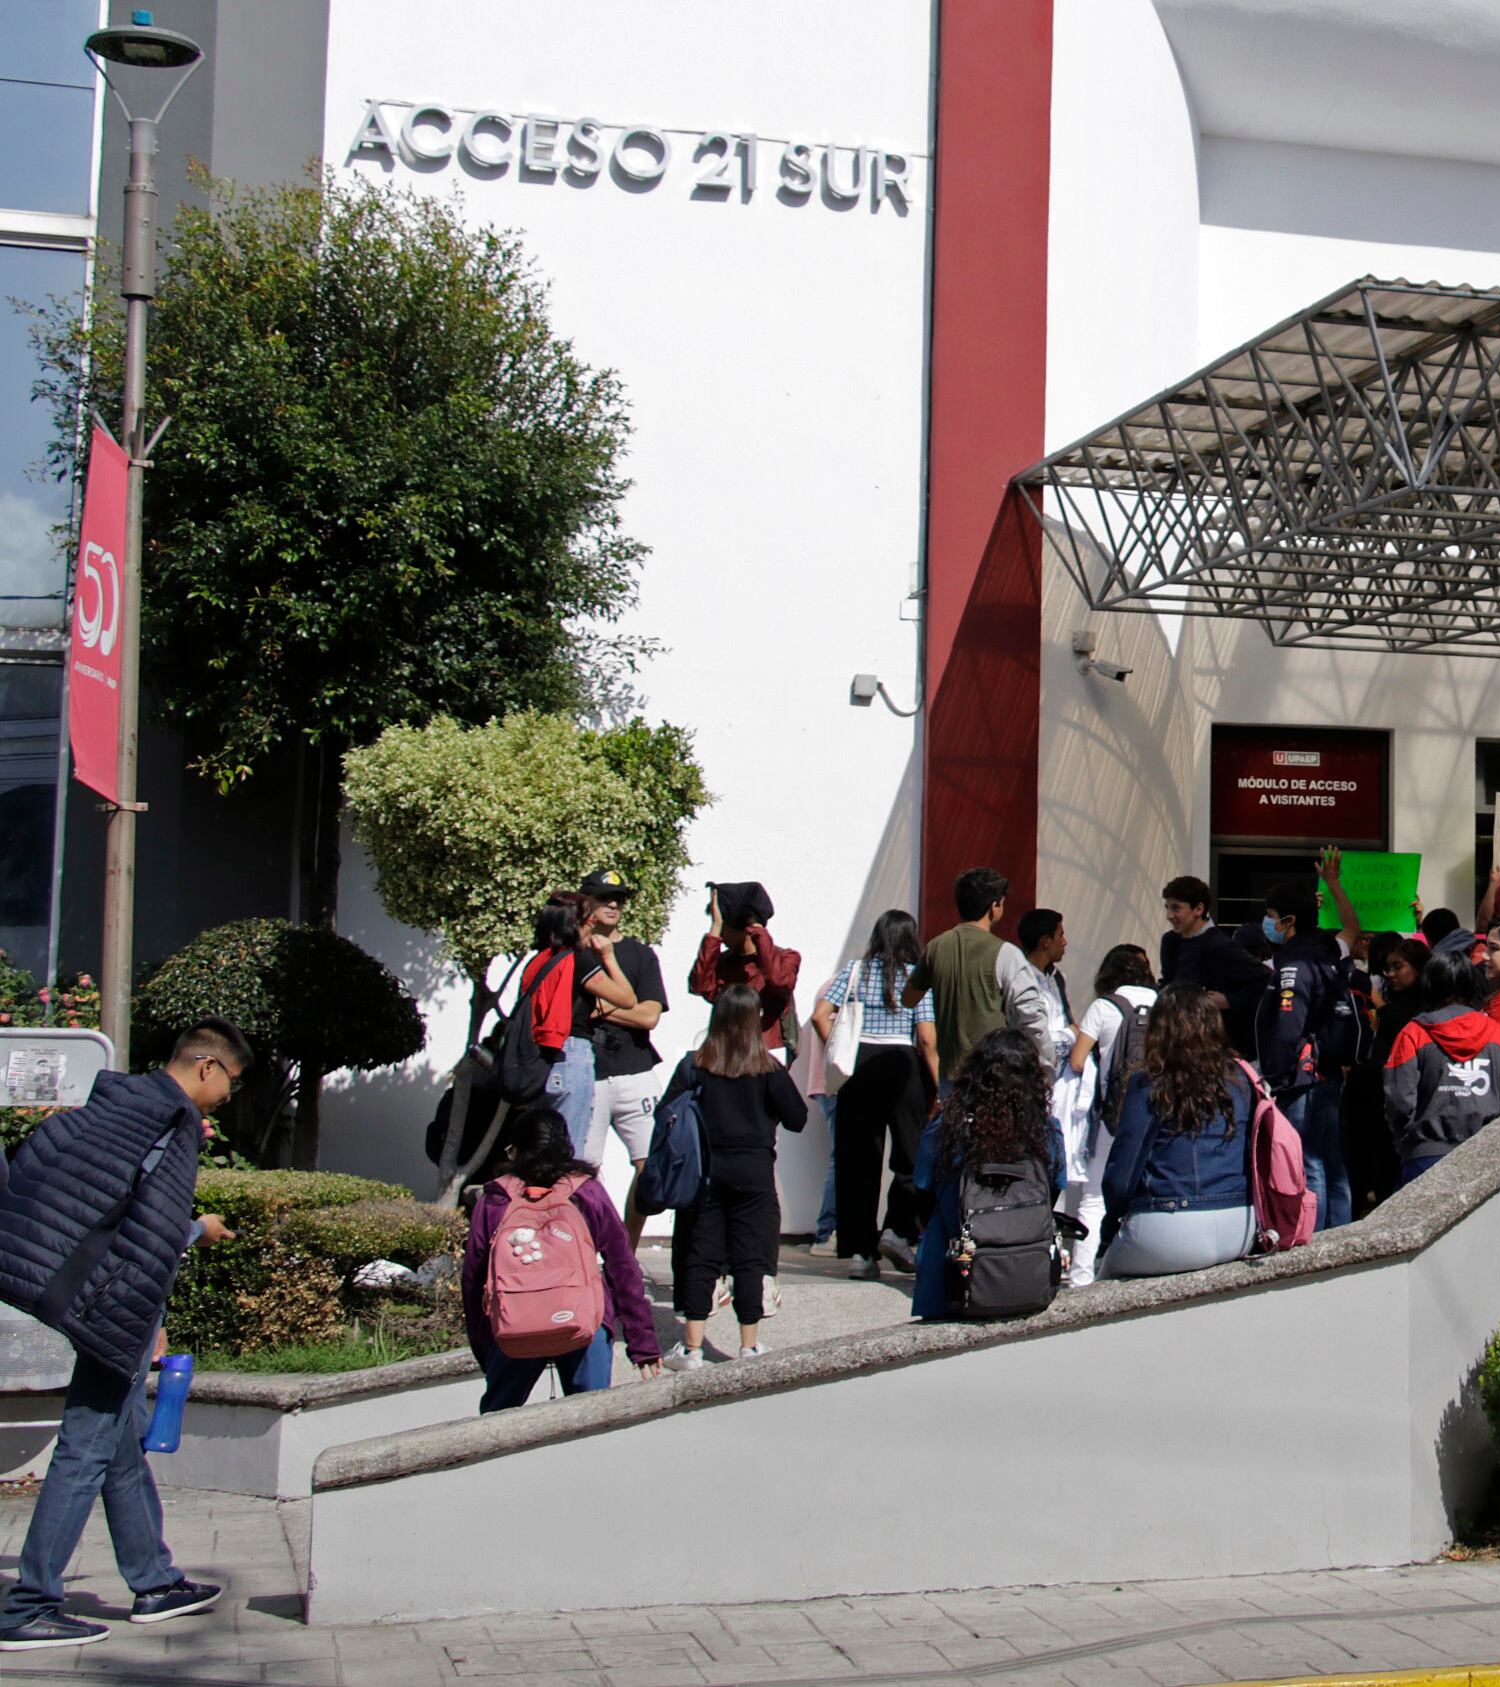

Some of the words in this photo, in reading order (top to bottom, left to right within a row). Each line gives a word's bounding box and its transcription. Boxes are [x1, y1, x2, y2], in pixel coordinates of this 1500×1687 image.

[350, 99, 671, 182] ACCESO
[696, 131, 760, 191] 21
[780, 142, 914, 203] SUR
[1287, 753, 1318, 764] UPAEP
[1237, 776, 1288, 789] MÓDULO
[1291, 779, 1307, 790] DE
[1308, 780, 1357, 791] ACCESO
[1259, 794, 1269, 805] A
[1270, 794, 1336, 806] VISITANTES
